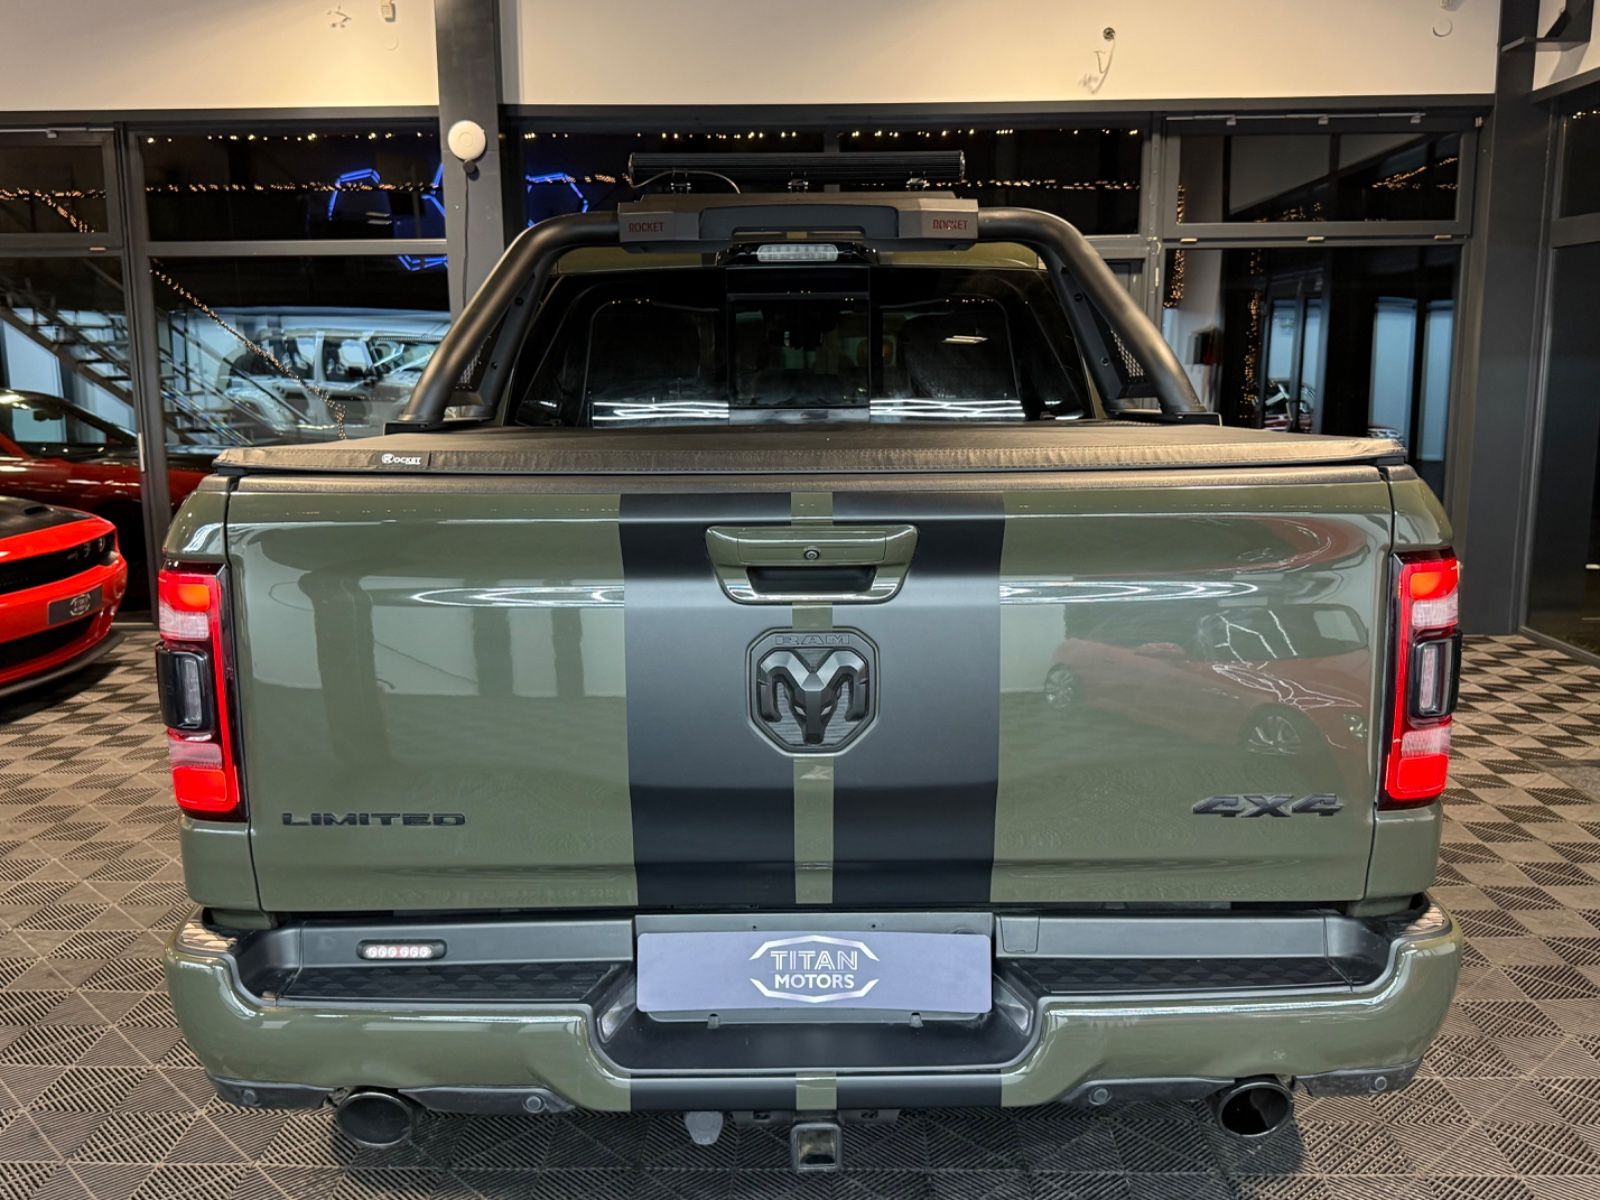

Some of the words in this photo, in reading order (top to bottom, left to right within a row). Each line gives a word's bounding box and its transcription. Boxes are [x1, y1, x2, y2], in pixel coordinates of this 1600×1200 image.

[628, 223, 664, 232] ROCKET
[775, 635, 850, 645] RAM
[282, 813, 466, 826] LIMITED
[770, 950, 858, 971] TITAN
[775, 974, 855, 989] MOTORS
